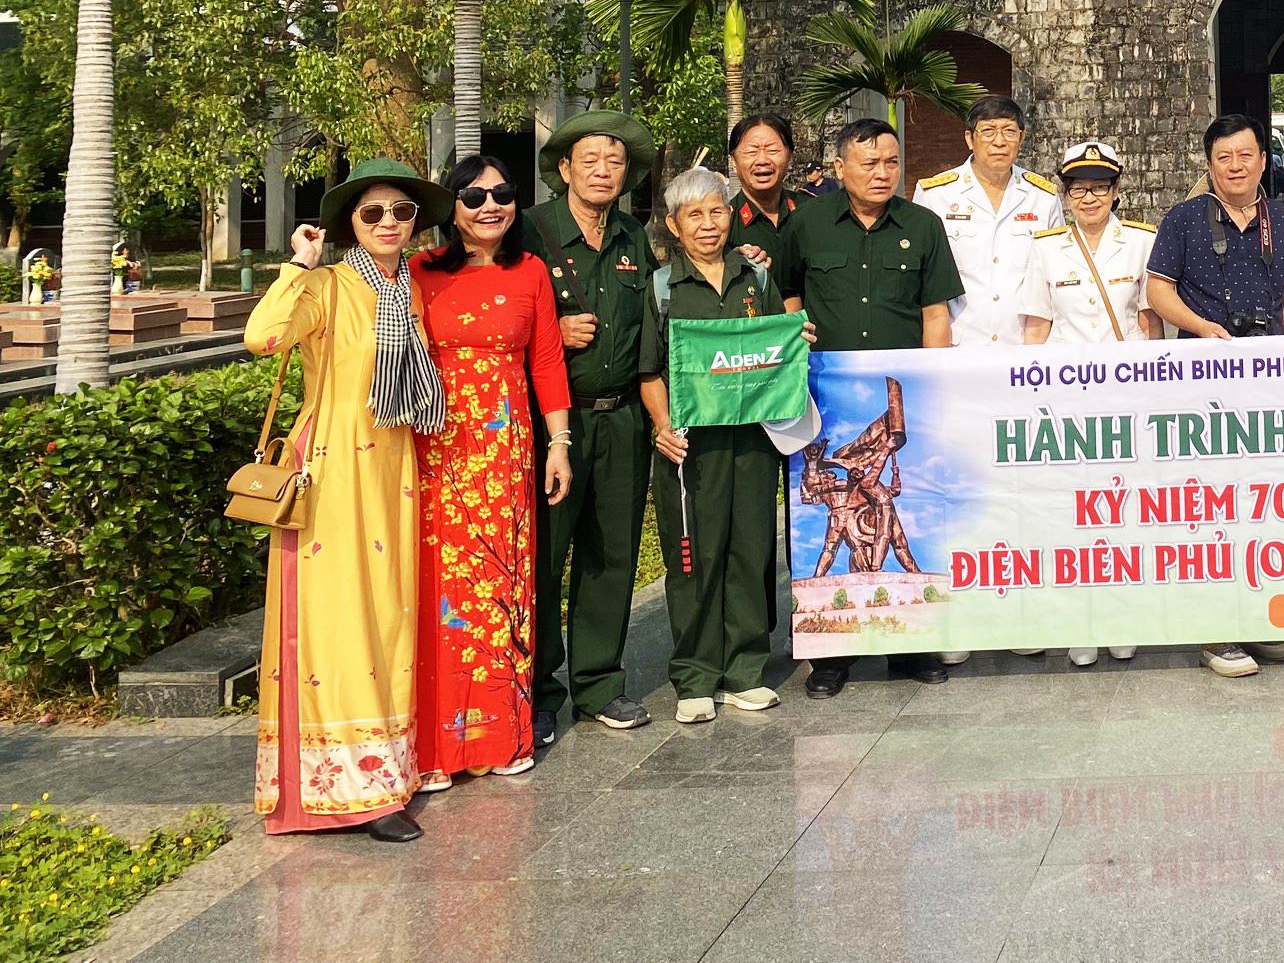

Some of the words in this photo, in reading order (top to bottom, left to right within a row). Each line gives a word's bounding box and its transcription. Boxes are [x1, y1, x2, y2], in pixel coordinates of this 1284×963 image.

[1011, 361, 1050, 392] HỘI
[1059, 362, 1106, 390] CỰU
[1115, 353, 1183, 383] CHIẾN
[1192, 359, 1244, 379] BINH
[997, 407, 1133, 462] HÀNH
[1076, 477, 1126, 525] KỶ
[1139, 476, 1235, 530] NIỆM
[951, 542, 1041, 594] ĐIỆN
[1055, 537, 1141, 584] BIÊN
[1155, 531, 1232, 581] PHỦ
